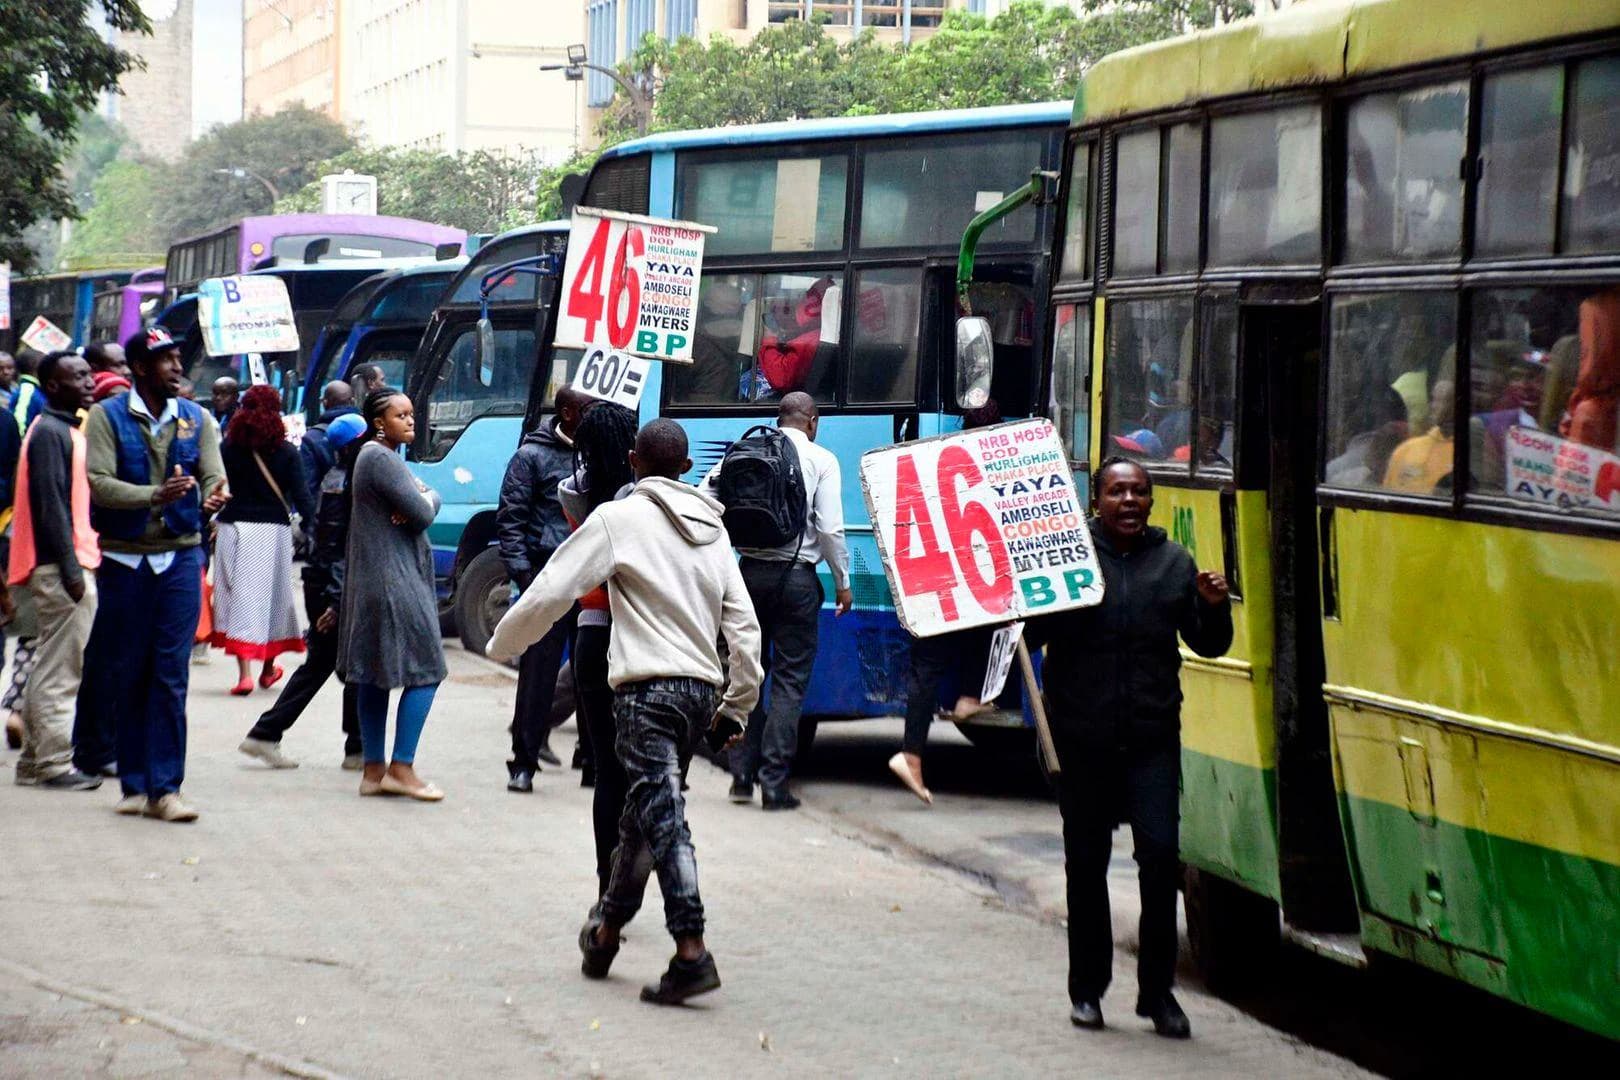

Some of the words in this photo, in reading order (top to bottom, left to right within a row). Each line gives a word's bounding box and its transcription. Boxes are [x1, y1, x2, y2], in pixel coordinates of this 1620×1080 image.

[649, 236, 674, 246] DOD
[650, 225, 671, 237] NRB
[674, 228, 701, 241] HOSP
[647, 244, 698, 257] HURLIGHAM
[646, 261, 694, 277] YAYA
[567, 217, 645, 350] 46
[644, 282, 692, 297] AMBOSELI
[640, 302, 691, 319] KAWAGWARE
[642, 291, 692, 307] CONGO
[639, 314, 689, 331] MYERS
[582, 350, 643, 399] 60/=
[978, 434, 1009, 450] NRB
[1013, 425, 1053, 444] HOSP
[981, 446, 1019, 461] DOD
[987, 468, 1025, 484] CHAKA
[1027, 461, 1063, 477] PLACE
[990, 473, 1067, 498] YAYA
[994, 496, 1030, 511] VALLEY
[1033, 488, 1070, 503] ARCADE
[1001, 499, 1074, 526] AMBOSELI
[894, 445, 1015, 623] 46
[1003, 513, 1079, 540] CONGO
[1007, 528, 1084, 555] KAWAGWARE
[1013, 543, 1090, 574] MYERS
